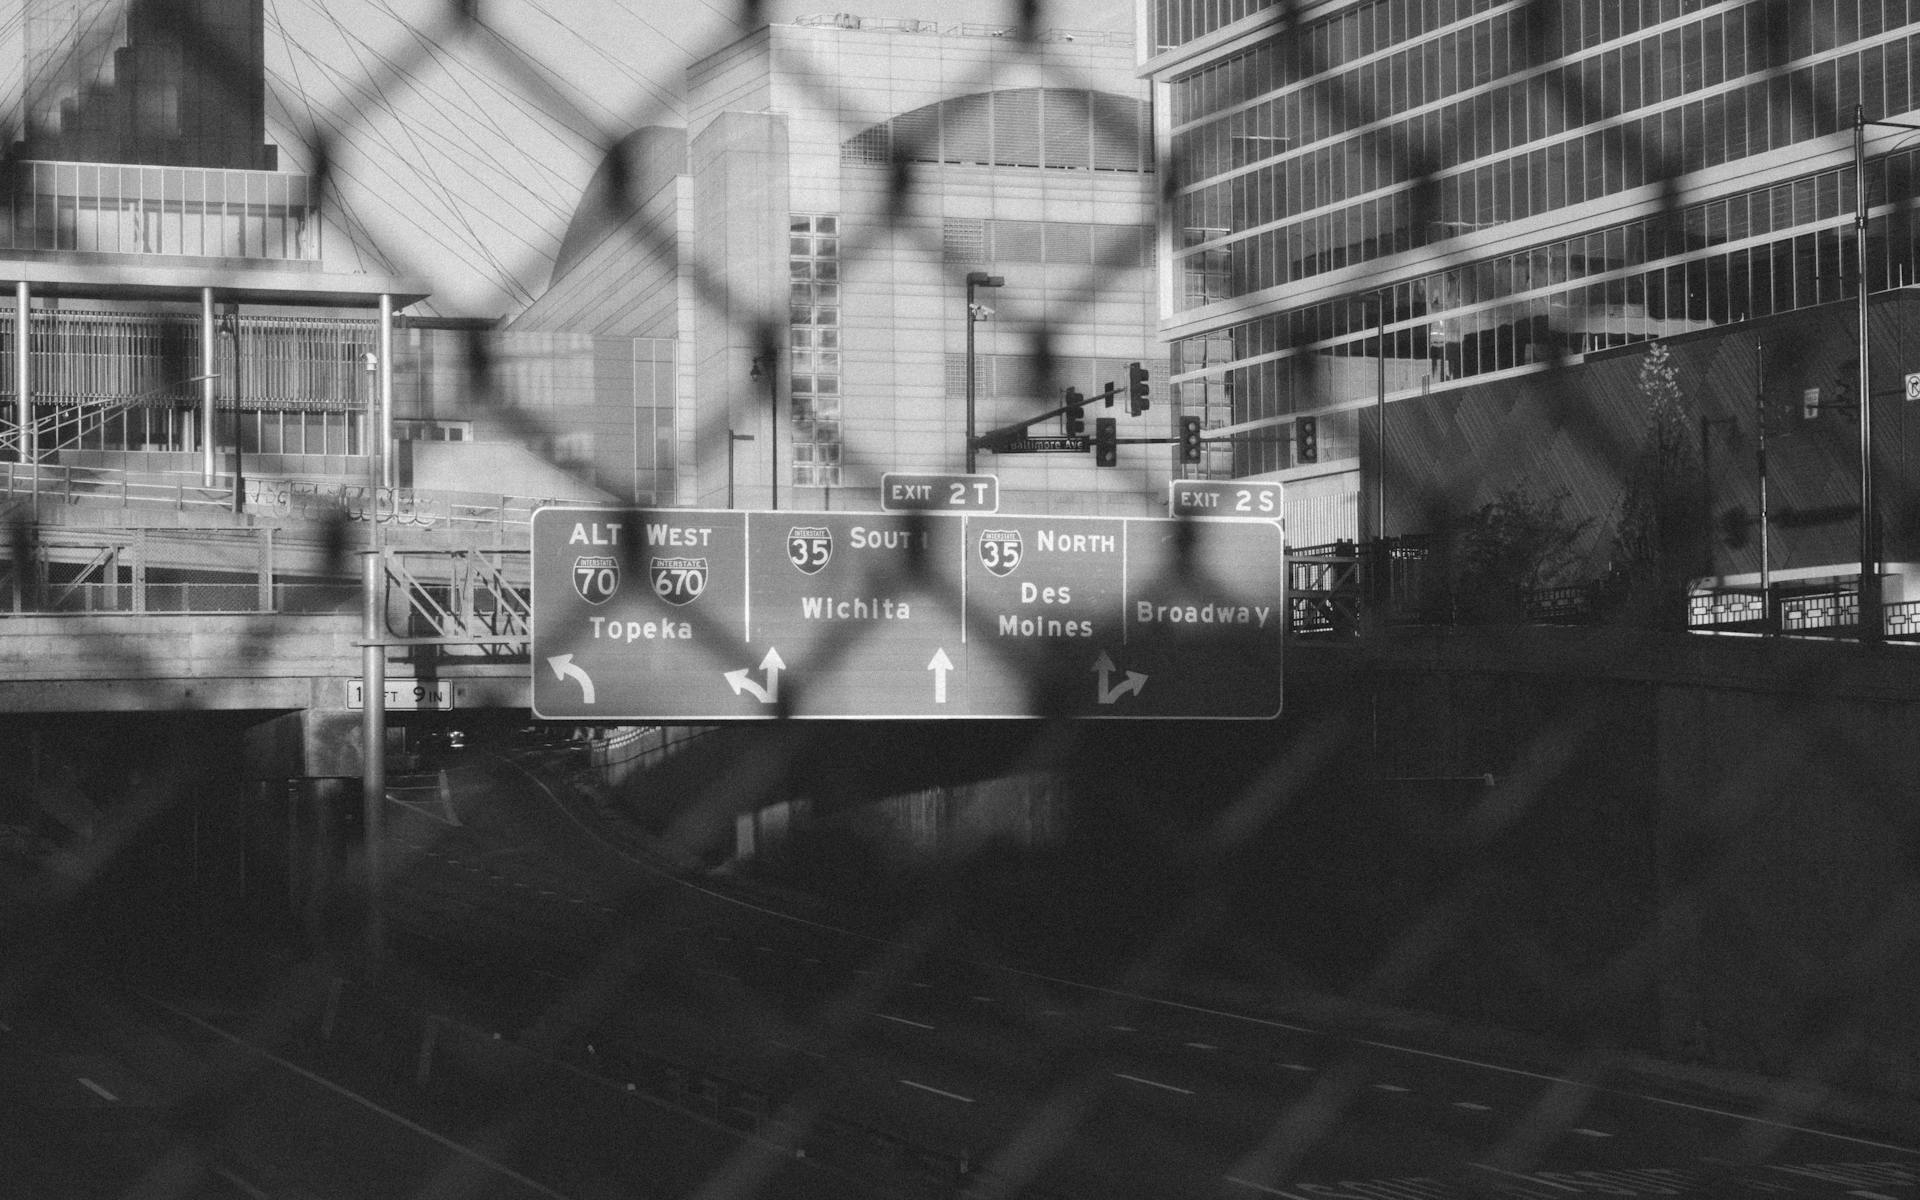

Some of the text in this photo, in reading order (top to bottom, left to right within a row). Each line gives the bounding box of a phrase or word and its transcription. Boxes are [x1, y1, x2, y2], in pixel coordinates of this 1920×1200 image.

[1065, 440, 1084, 450] Ave
[892, 485, 932, 500] EXIT
[1181, 491, 1220, 508] EXIT
[569, 523, 622, 545] ALT
[646, 524, 712, 546] WEST
[1037, 530, 1115, 553] NORTH
[656, 560, 701, 568] INTERSTATE
[792, 539, 829, 566] 35
[983, 541, 1019, 567] 35
[577, 568, 616, 595] 70
[655, 570, 703, 596] 670
[1021, 582, 1071, 605] Des
[801, 597, 910, 620] Wichita
[1137, 600, 1270, 628] Broadway
[589, 616, 693, 643] Topeka
[999, 614, 1093, 638] Moines
[413, 686, 426, 702] 9
[428, 691, 443, 703] IN
